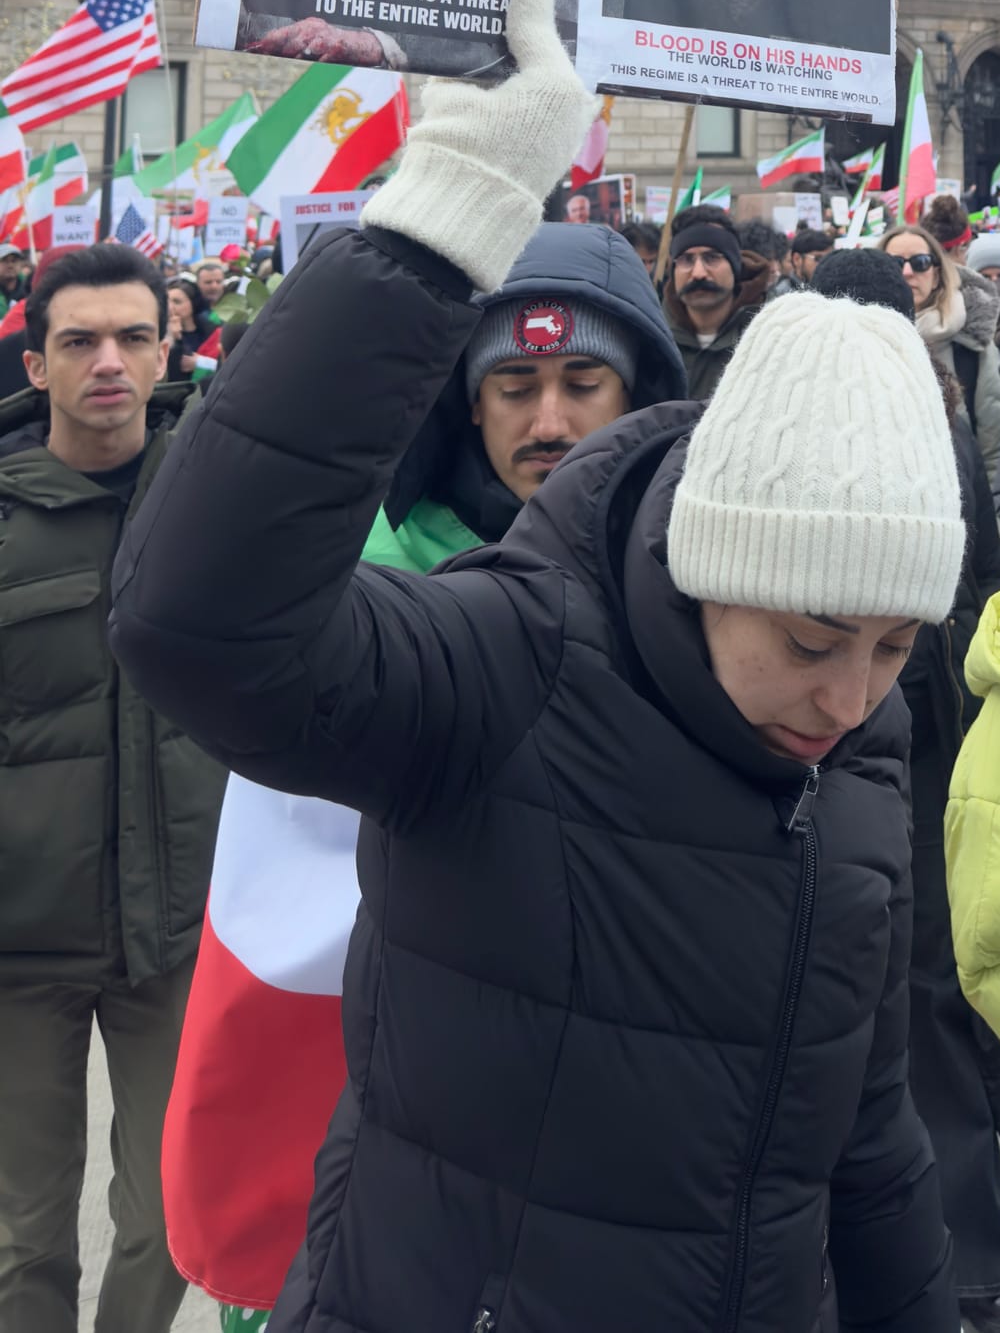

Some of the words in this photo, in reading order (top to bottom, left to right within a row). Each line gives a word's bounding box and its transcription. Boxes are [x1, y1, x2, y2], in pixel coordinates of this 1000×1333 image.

[379, 3, 439, 27] ENTIRE
[634, 30, 704, 54] BLOOD
[710, 40, 727, 56] IS
[733, 43, 761, 60] ON
[767, 48, 795, 65] HIS
[801, 53, 862, 74] HANDS
[667, 50, 693, 64] THE
[697, 54, 746, 70] WORLD
[750, 60, 762, 72] IS
[765, 63, 833, 81] WATCHING
[610, 63, 637, 76] THIS
[640, 67, 684, 82] REGIME
[687, 73, 698, 84] IS
[701, 75, 709, 84] A
[712, 76, 757, 90] THREAT
[760, 81, 775, 92] TO
[778, 83, 798, 95] THE
[801, 87, 839, 100] ENTIRE
[841, 92, 881, 105] WORLD.
[295, 203, 332, 215] JUSTICE
[338, 201, 355, 211] FOR
[65, 215, 81, 224] WE
[56, 233, 90, 242] WANT
[524, 301, 565, 315] BOSTON
